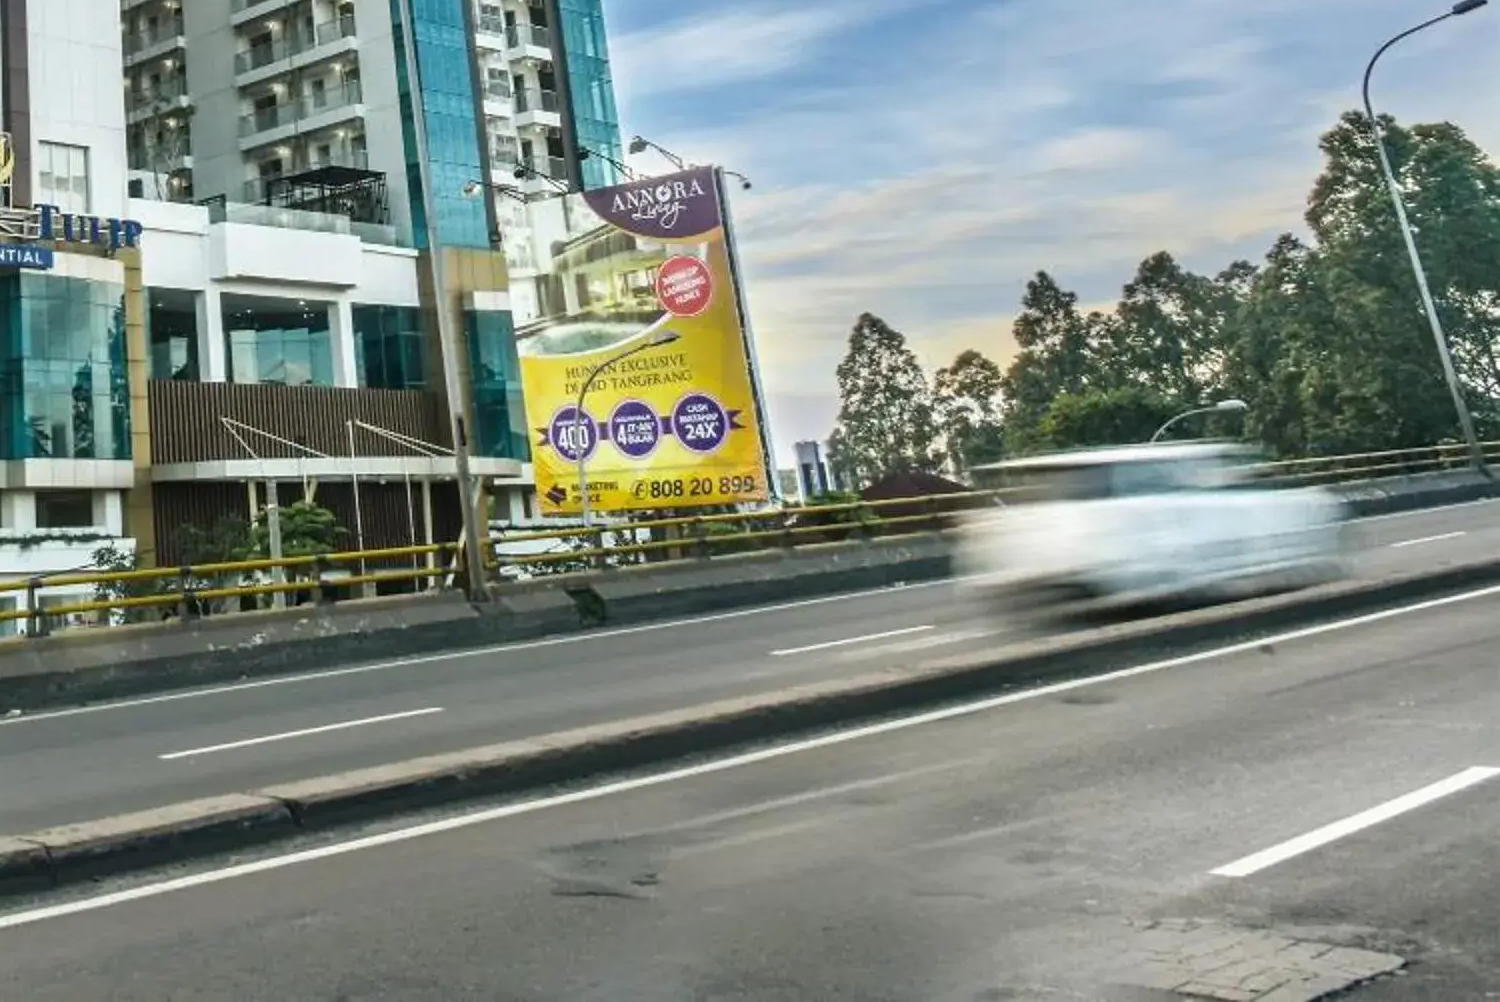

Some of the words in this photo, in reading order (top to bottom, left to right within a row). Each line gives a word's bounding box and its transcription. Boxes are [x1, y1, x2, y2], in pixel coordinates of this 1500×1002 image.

[611, 178, 706, 213] ANNORA
[33, 203, 143, 249] TULIP
[631, 199, 687, 229] Living
[621, 352, 688, 373] EXCLUSIVE
[611, 369, 694, 391] TANGERANG
[650, 480, 684, 498] 808
[689, 477, 713, 496] 20
[719, 475, 755, 495] 899
